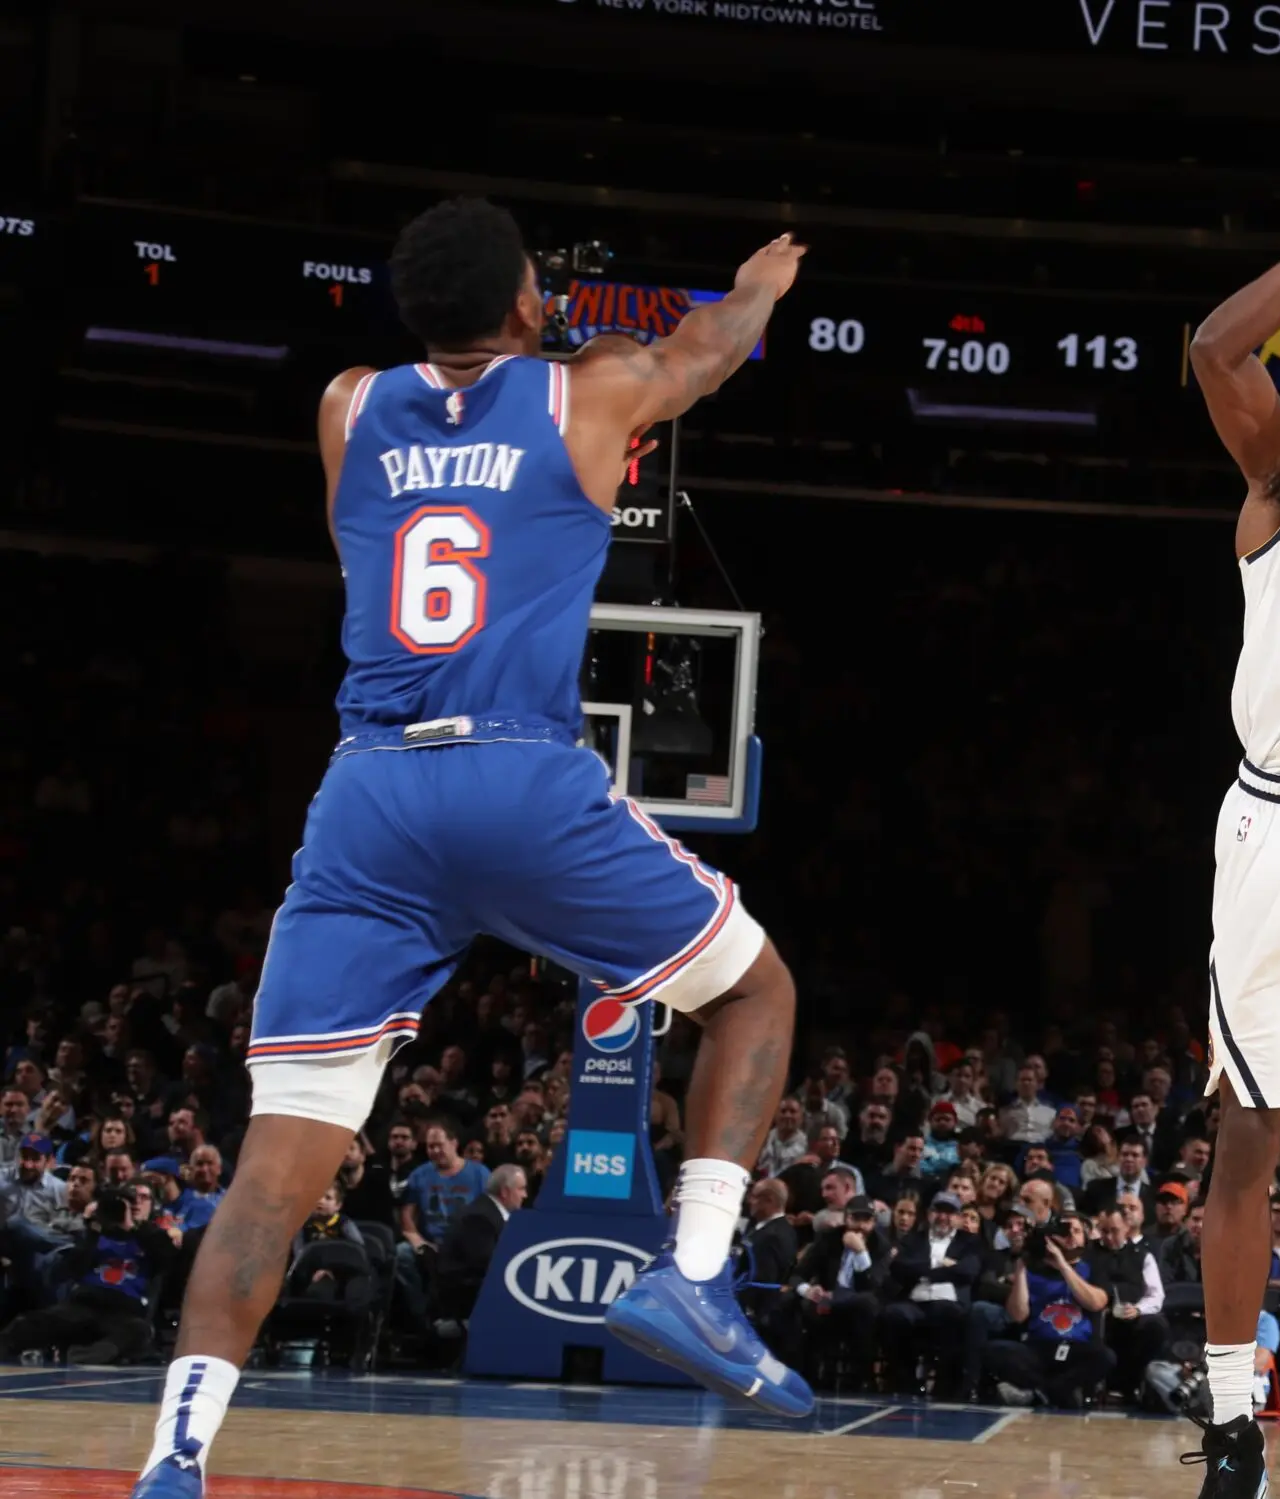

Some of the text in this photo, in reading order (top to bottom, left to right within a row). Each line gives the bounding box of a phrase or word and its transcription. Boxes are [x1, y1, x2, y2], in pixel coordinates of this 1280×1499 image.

[654, 0, 707, 15] YORK
[712, 5, 811, 25] MIDTOWN
[817, 11, 883, 31] HOTEL
[136, 243, 176, 262] TOL
[144, 264, 159, 285] 1
[303, 261, 372, 284] FOULS
[329, 283, 344, 308] 1
[810, 319, 865, 354] 80
[925, 340, 1010, 374] 7:00
[1059, 335, 1138, 371] 113
[379, 442, 526, 498] PAYTON
[610, 507, 662, 528] SOT
[390, 506, 491, 654] 6
[584, 1057, 632, 1073] pepsi
[579, 1075, 635, 1085] ZERO SUGAR
[573, 1153, 626, 1177] HSS
[534, 1255, 637, 1304] KIA
